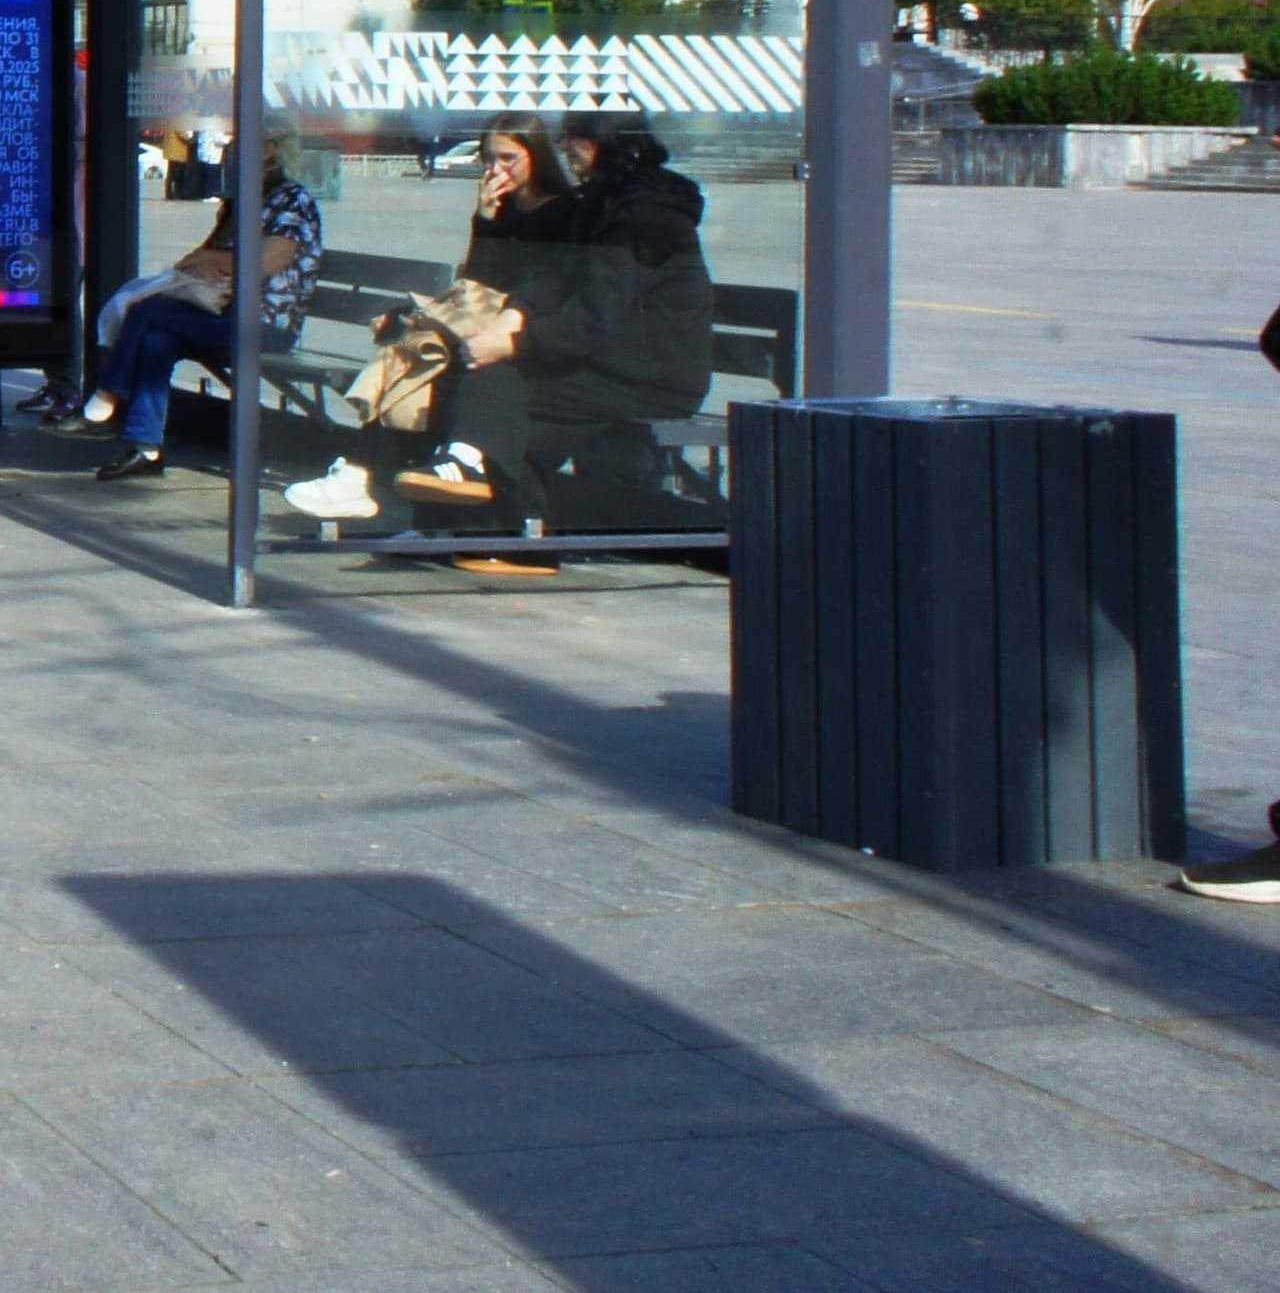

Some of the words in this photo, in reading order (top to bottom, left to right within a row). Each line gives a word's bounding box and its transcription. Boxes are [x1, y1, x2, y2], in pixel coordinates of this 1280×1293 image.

[25, 31, 40, 44] 31
[30, 45, 39, 58] В
[5, 88, 39, 101] МСК
[9, 260, 37, 279] 6+
